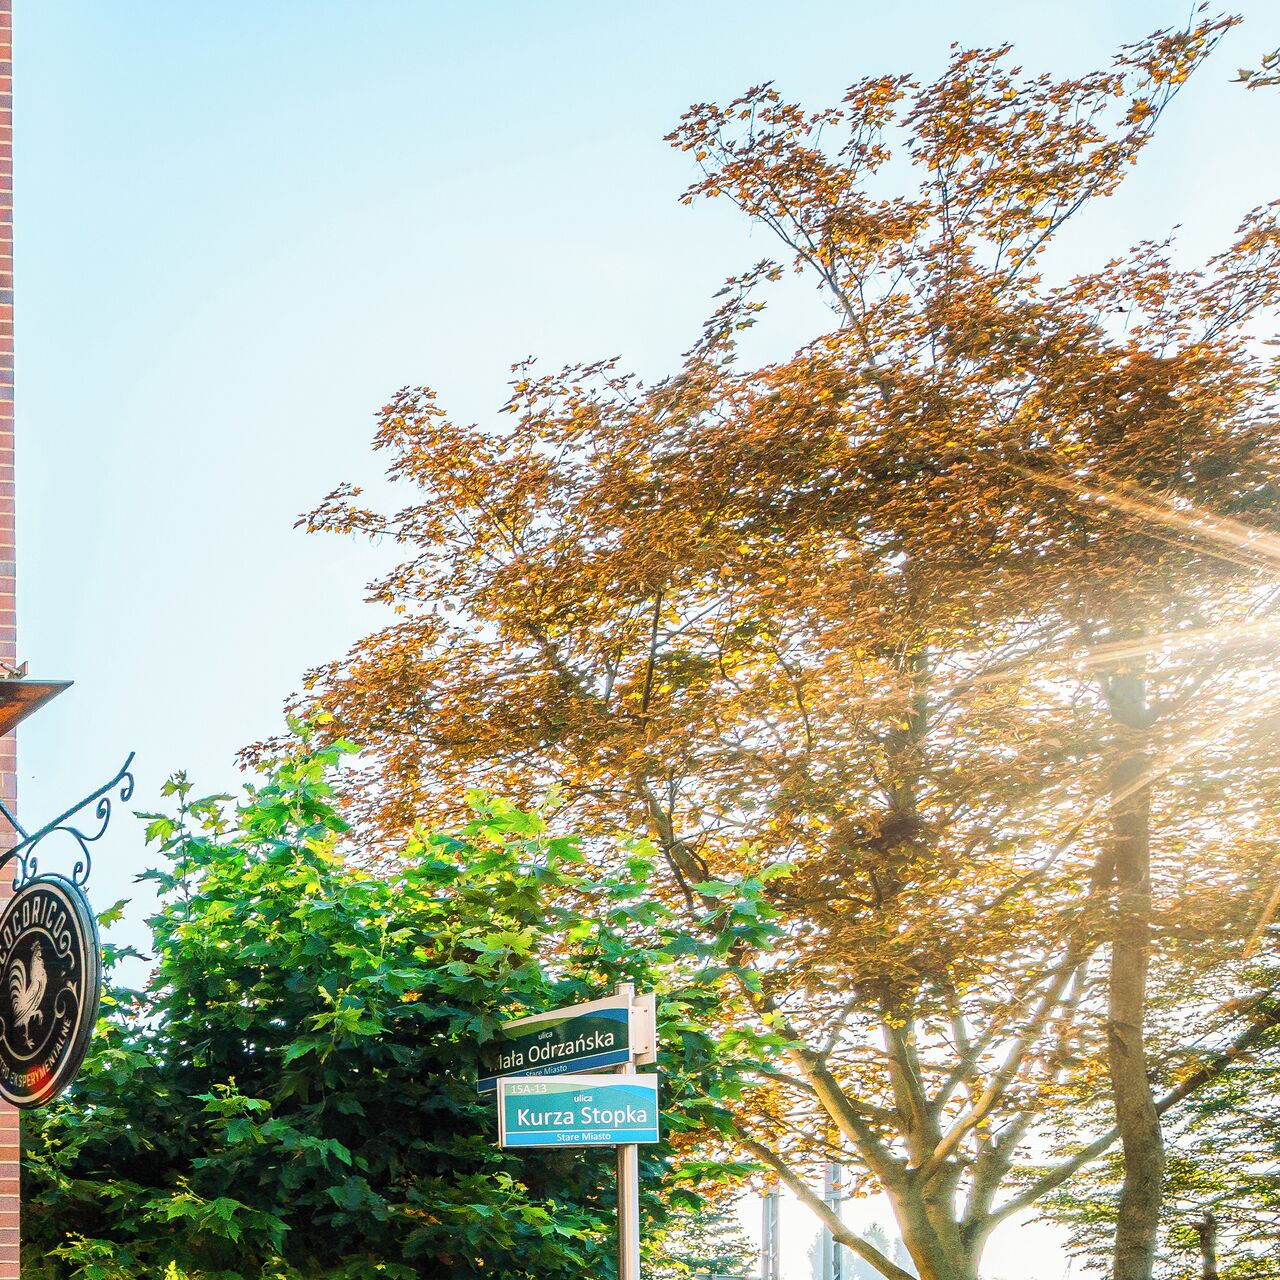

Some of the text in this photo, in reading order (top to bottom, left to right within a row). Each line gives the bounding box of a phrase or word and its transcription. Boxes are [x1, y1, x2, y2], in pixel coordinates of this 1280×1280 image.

[538, 1030, 553, 1040] ulica
[528, 1030, 615, 1063] Odrzańska
[544, 1064, 568, 1076] Miasto
[517, 1105, 647, 1127] Kurza Stopka
[556, 1132, 611, 1142] Stare Miasto
